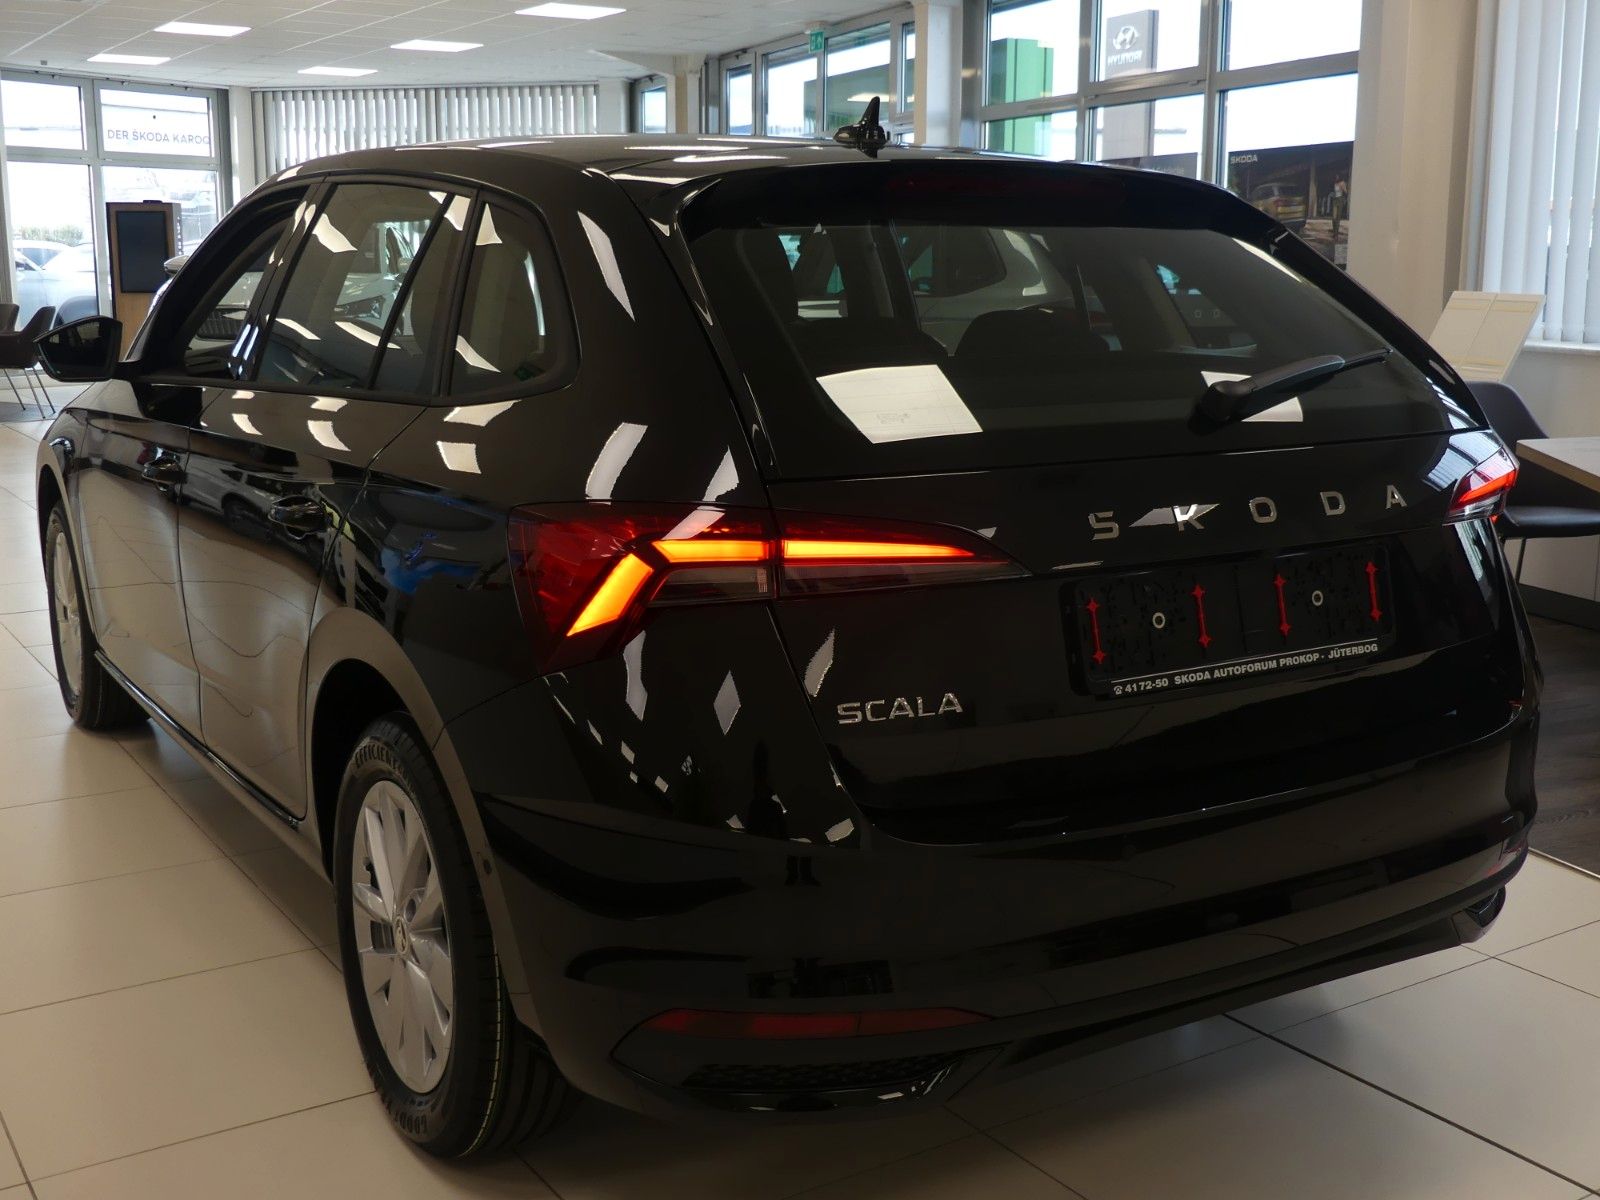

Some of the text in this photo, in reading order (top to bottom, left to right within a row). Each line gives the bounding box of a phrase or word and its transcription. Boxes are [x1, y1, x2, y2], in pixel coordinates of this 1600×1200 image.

[107, 129, 129, 140] DER
[132, 129, 170, 142] ŠKODA
[1173, 672, 1211, 685] SKODA
[1213, 660, 1278, 678] AUTOFORUM
[1279, 653, 1320, 667] PROKOP
[1327, 643, 1379, 660] JÜTERBOG
[836, 692, 964, 725] SCALA
